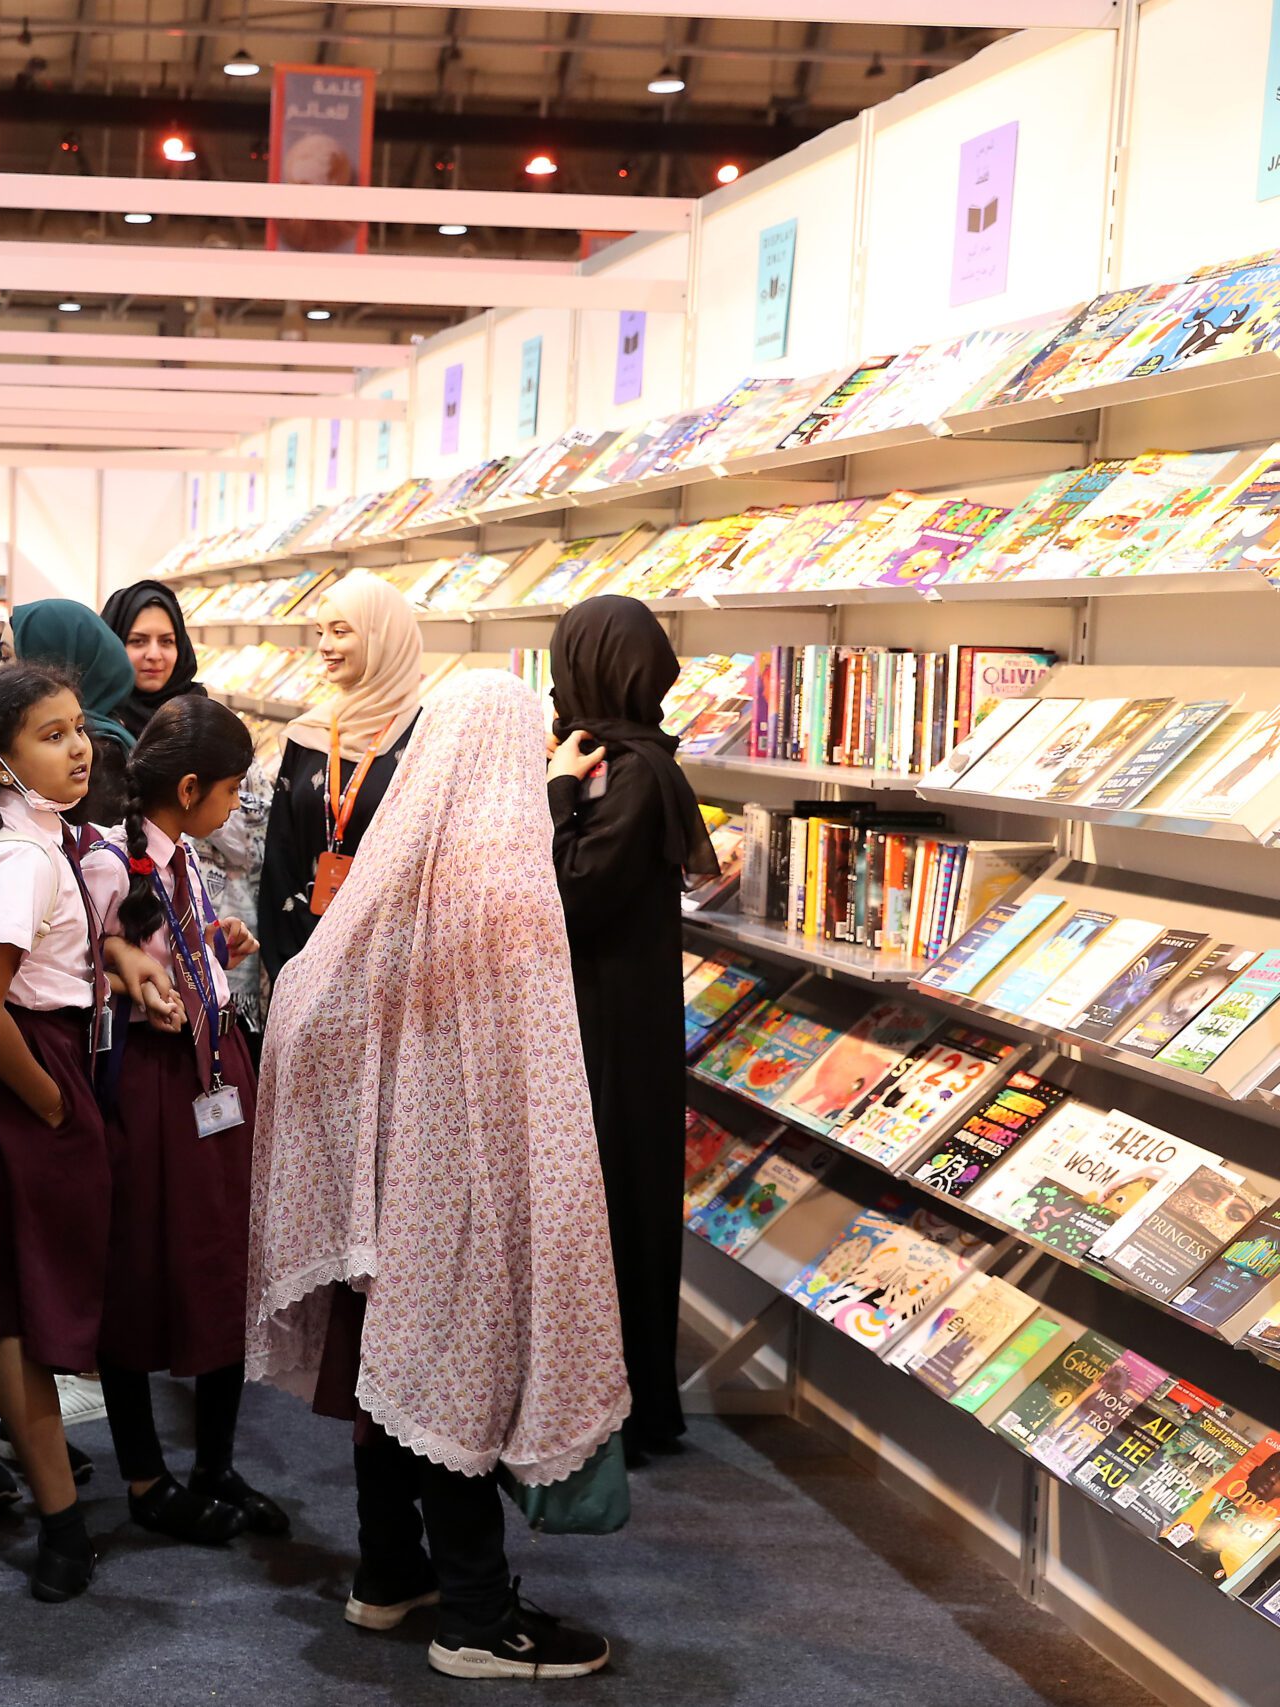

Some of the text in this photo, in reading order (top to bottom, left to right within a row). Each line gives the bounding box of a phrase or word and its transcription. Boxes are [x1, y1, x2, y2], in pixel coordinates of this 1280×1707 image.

[1148, 740, 1175, 751] LAST
[1109, 1127, 1177, 1163] HELLO
[1064, 1150, 1120, 1187] WORM
[1146, 1215, 1211, 1260] PRINCESS
[1133, 1268, 1172, 1295] SASSON
[1096, 1388, 1133, 1420] WOME
[1120, 1393, 1133, 1404] THE
[1117, 1436, 1155, 1467] HE
[1189, 1441, 1224, 1467] NOT
[1199, 1419, 1220, 1437] Shari
[1221, 1432, 1248, 1456] Lapena
[1153, 1462, 1202, 1502] HAPPY
[1183, 1462, 1200, 1476] A
[1138, 1475, 1189, 1514] FAMILY
[1226, 1480, 1278, 1520] Open
[1210, 1493, 1263, 1539] Water
